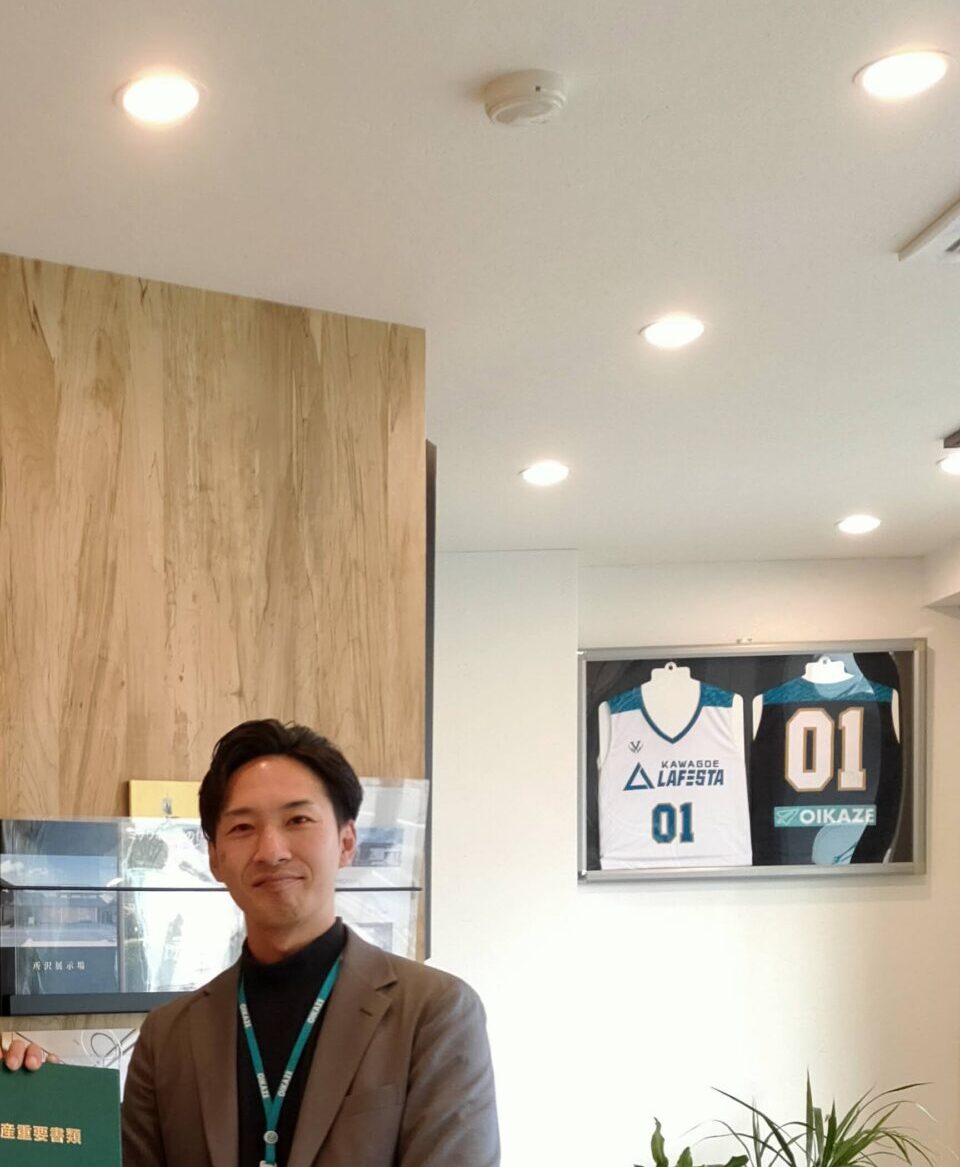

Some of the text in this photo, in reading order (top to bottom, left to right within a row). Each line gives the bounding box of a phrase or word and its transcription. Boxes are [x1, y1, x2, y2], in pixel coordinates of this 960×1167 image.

[784, 706, 866, 793] 01
[661, 760, 719, 769] KAWAGOE
[657, 769, 724, 787] LAFESTA
[651, 802, 694, 843] 01
[799, 808, 876, 824] OIKAZE
